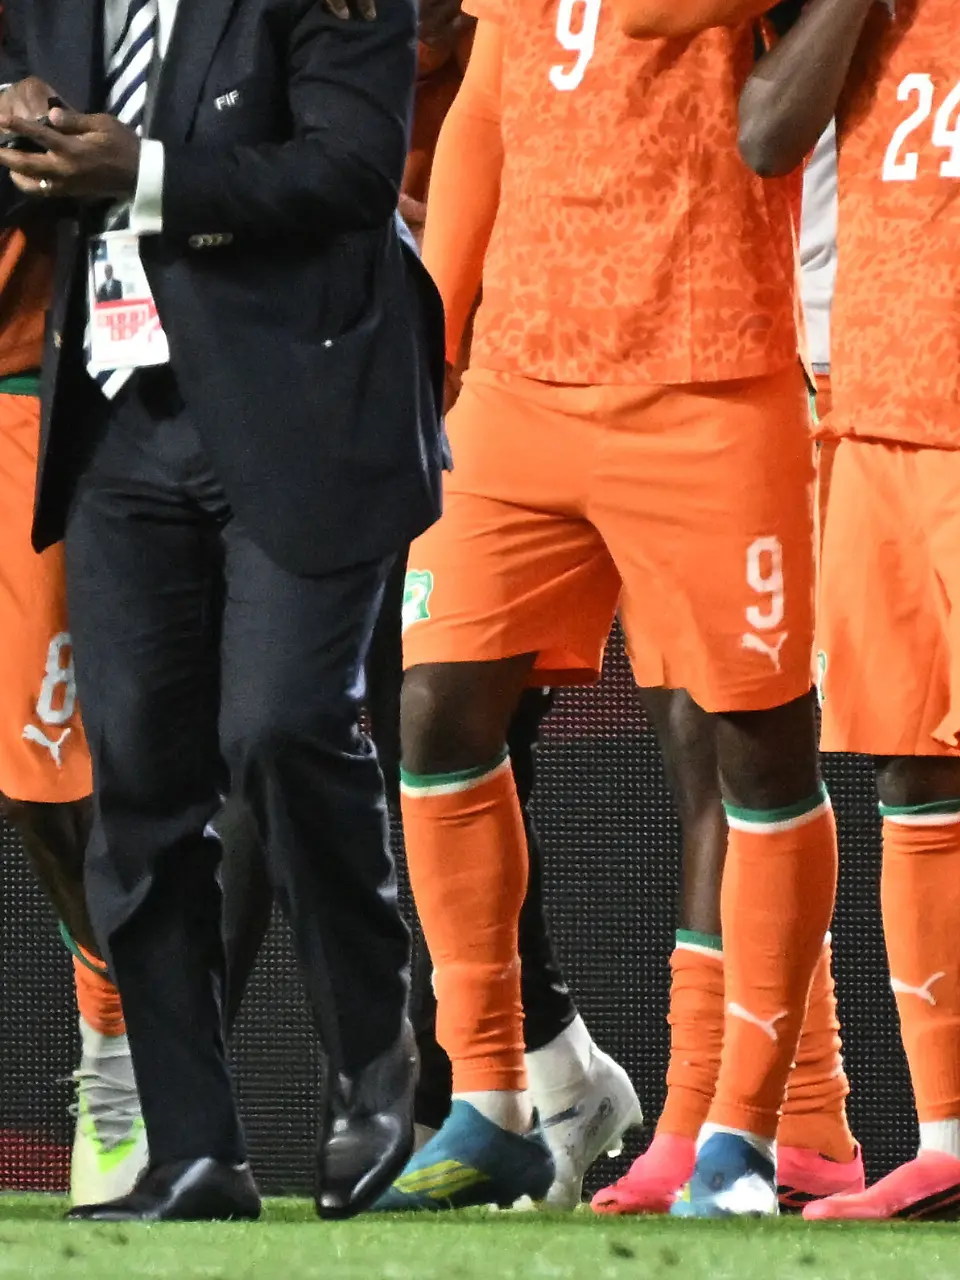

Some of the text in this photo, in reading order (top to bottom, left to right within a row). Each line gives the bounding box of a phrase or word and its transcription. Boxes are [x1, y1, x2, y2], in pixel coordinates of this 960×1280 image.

[214, 90, 239, 111] FIF
[746, 535, 784, 629] 9
[36, 632, 76, 724] 8
